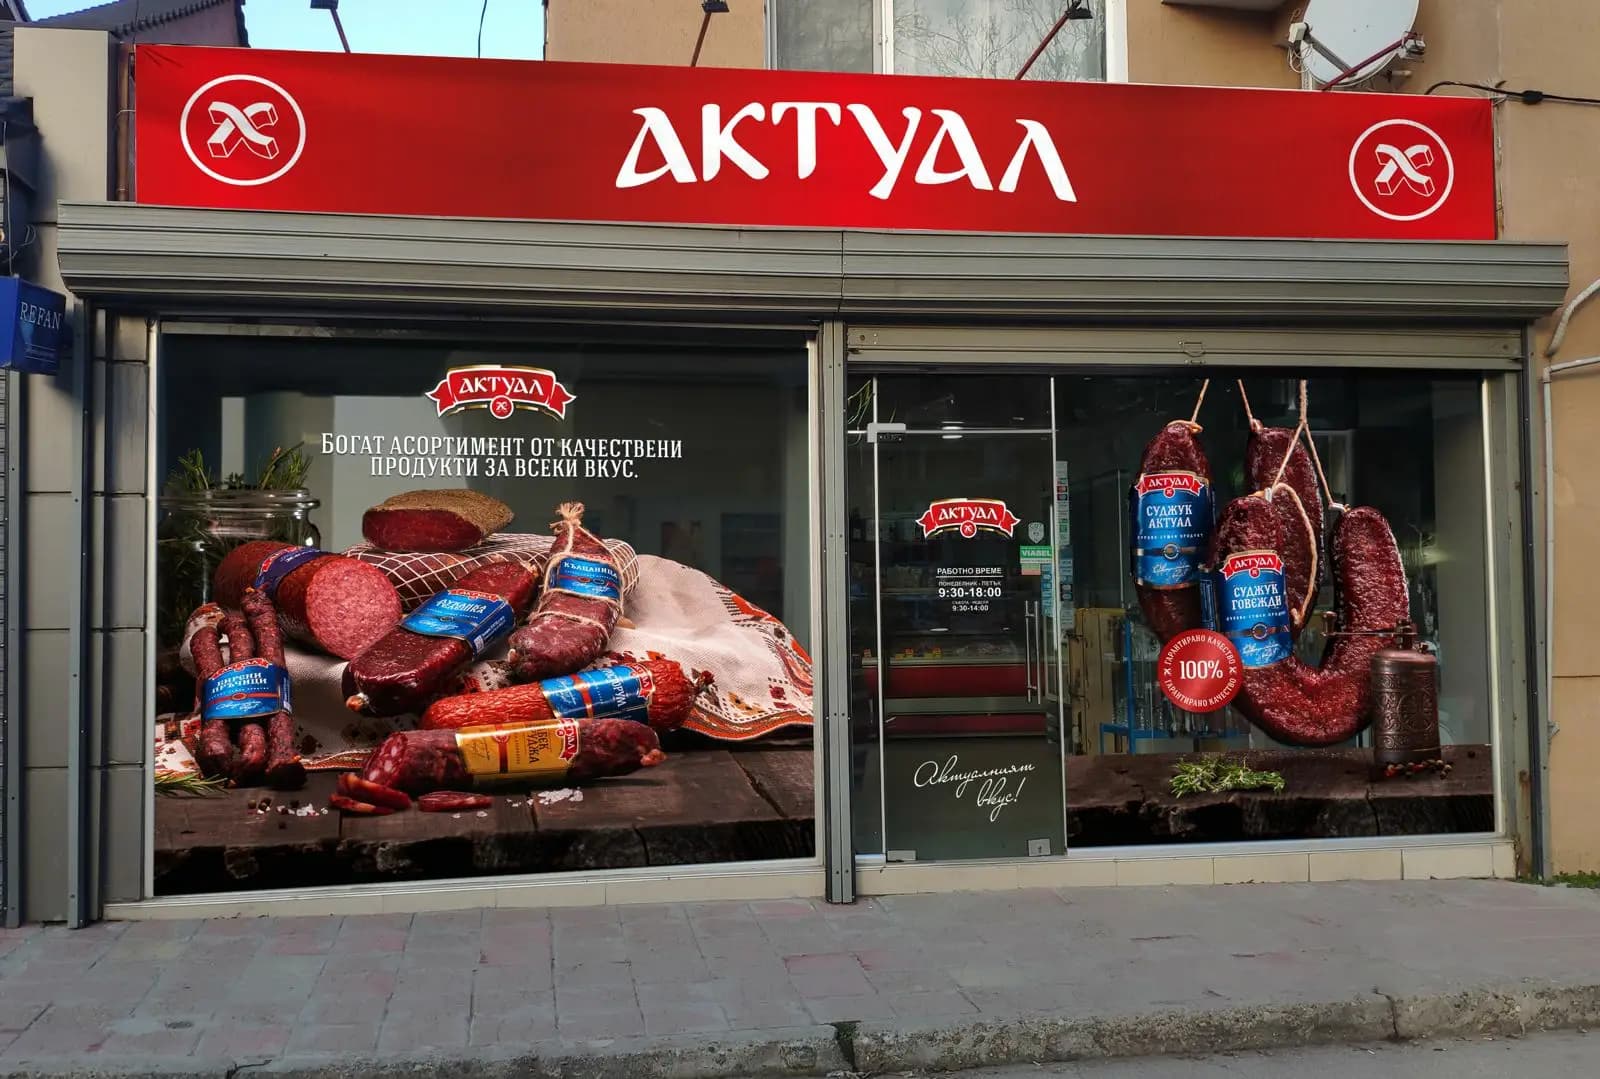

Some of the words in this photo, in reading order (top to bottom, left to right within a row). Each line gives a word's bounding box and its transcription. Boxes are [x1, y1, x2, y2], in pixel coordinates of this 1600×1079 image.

[615, 101, 1077, 203] АКТУАЛ
[20, 301, 62, 330] REFAN
[458, 375, 545, 397] АКТУАЛ
[321, 432, 385, 455] БОГАТ
[390, 435, 525, 457] АСОРТИМЕНТ
[530, 437, 555, 457] ОТ
[560, 438, 683, 459] КАЧЕСТВЕНИ
[370, 456, 479, 478] ПРОДУКТИ
[485, 458, 509, 477] ЗА
[514, 458, 578, 478] ВСЕКИ
[584, 459, 640, 479] ВКУС.
[1148, 477, 1190, 488] АКТУАЛ
[938, 506, 998, 521] АКТУАЛ
[1146, 504, 1193, 517] СУДЖУК
[1148, 517, 1192, 529] АКТУАЛ
[936, 567, 974, 575] РАБОТНО
[975, 567, 1002, 575] ВРЕМЕ
[1234, 557, 1274, 569] АКТУАЛ
[938, 587, 1002, 597] 9:30-18:00
[1233, 583, 1279, 598] СУДЖУК
[1231, 595, 1282, 611] ГОВЕЖДИ
[1164, 634, 1206, 665] ГАРАНТИРАНО
[1207, 635, 1236, 665] КАЧЕСТВО
[1180, 660, 1224, 679] 100%
[1164, 679, 1208, 707] ГАРАНТИРАНО
[1208, 678, 1237, 705] КАЧЕСТВО
[913, 755, 1036, 798] Актуалният
[976, 777, 1026, 822] вкус!
